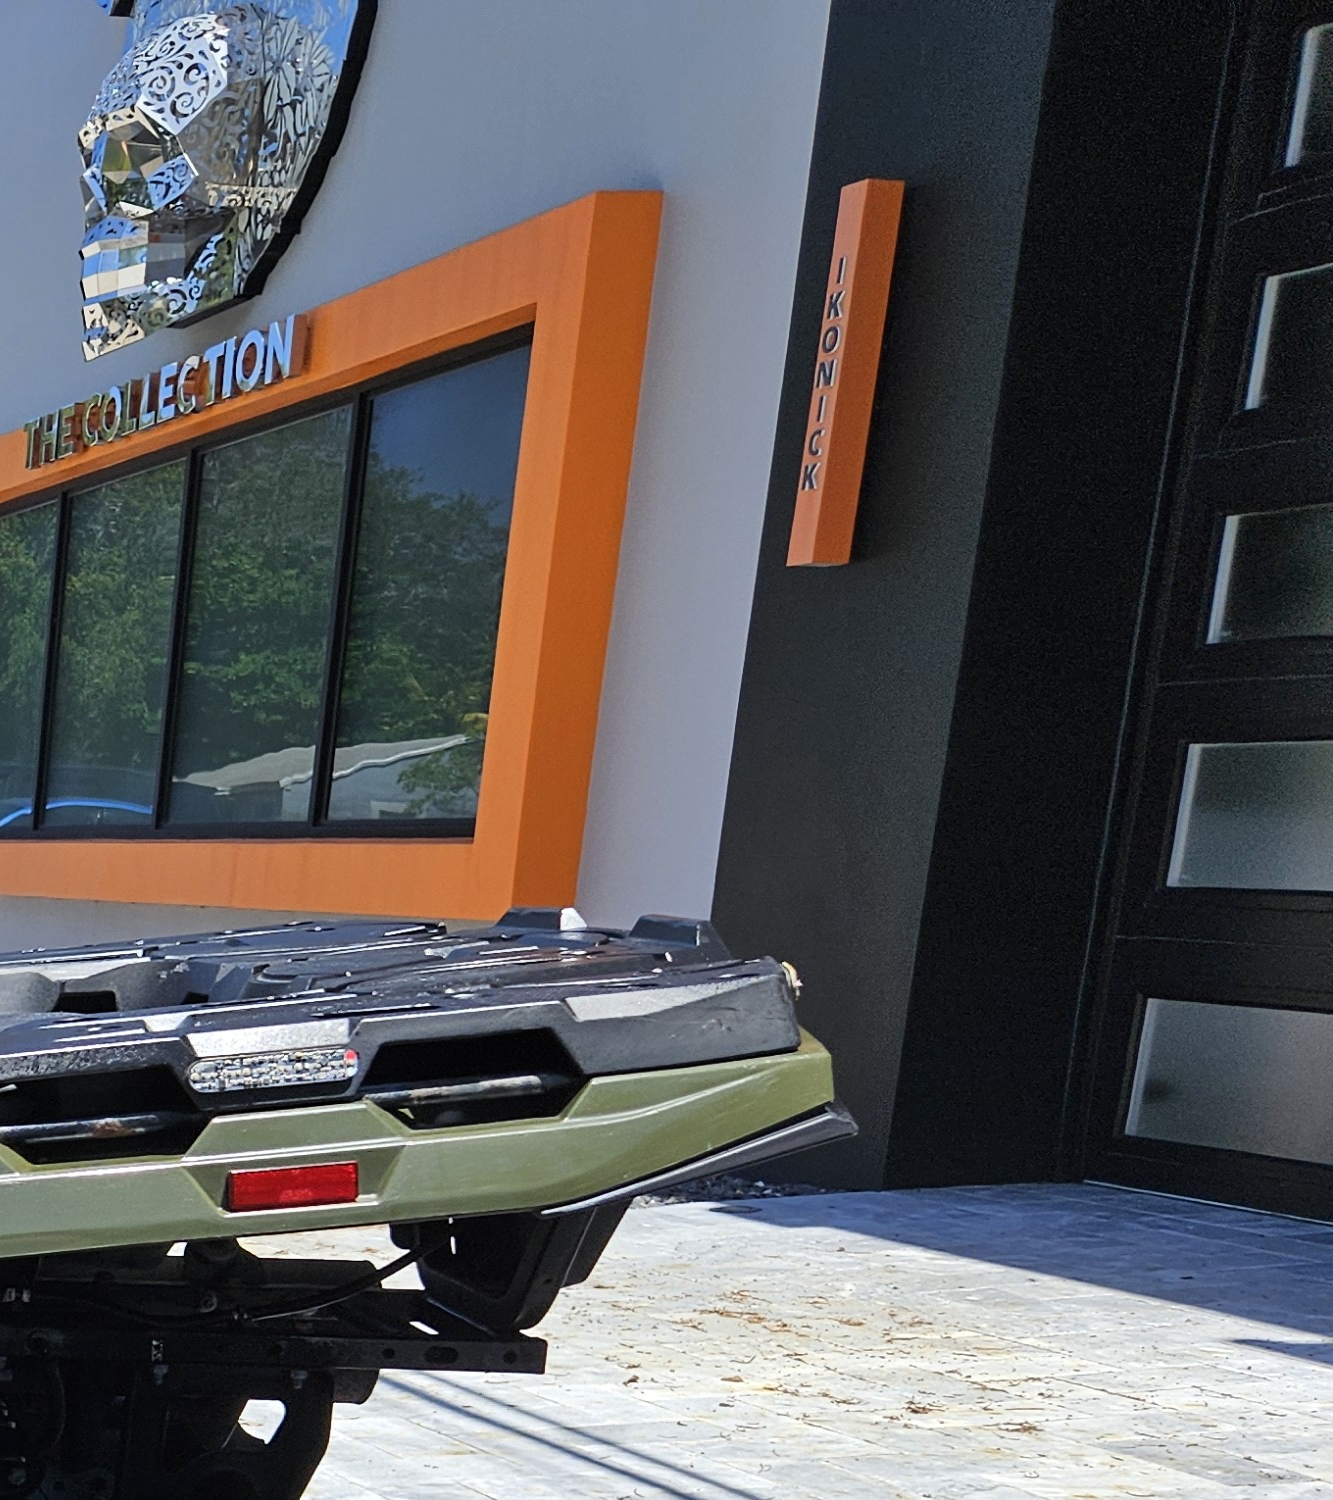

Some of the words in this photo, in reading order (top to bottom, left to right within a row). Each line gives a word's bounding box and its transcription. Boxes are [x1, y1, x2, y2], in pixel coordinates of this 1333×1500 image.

[24, 401, 76, 470] THE
[83, 314, 300, 446] COLLECTION
[801, 255, 846, 491] IKONICK
